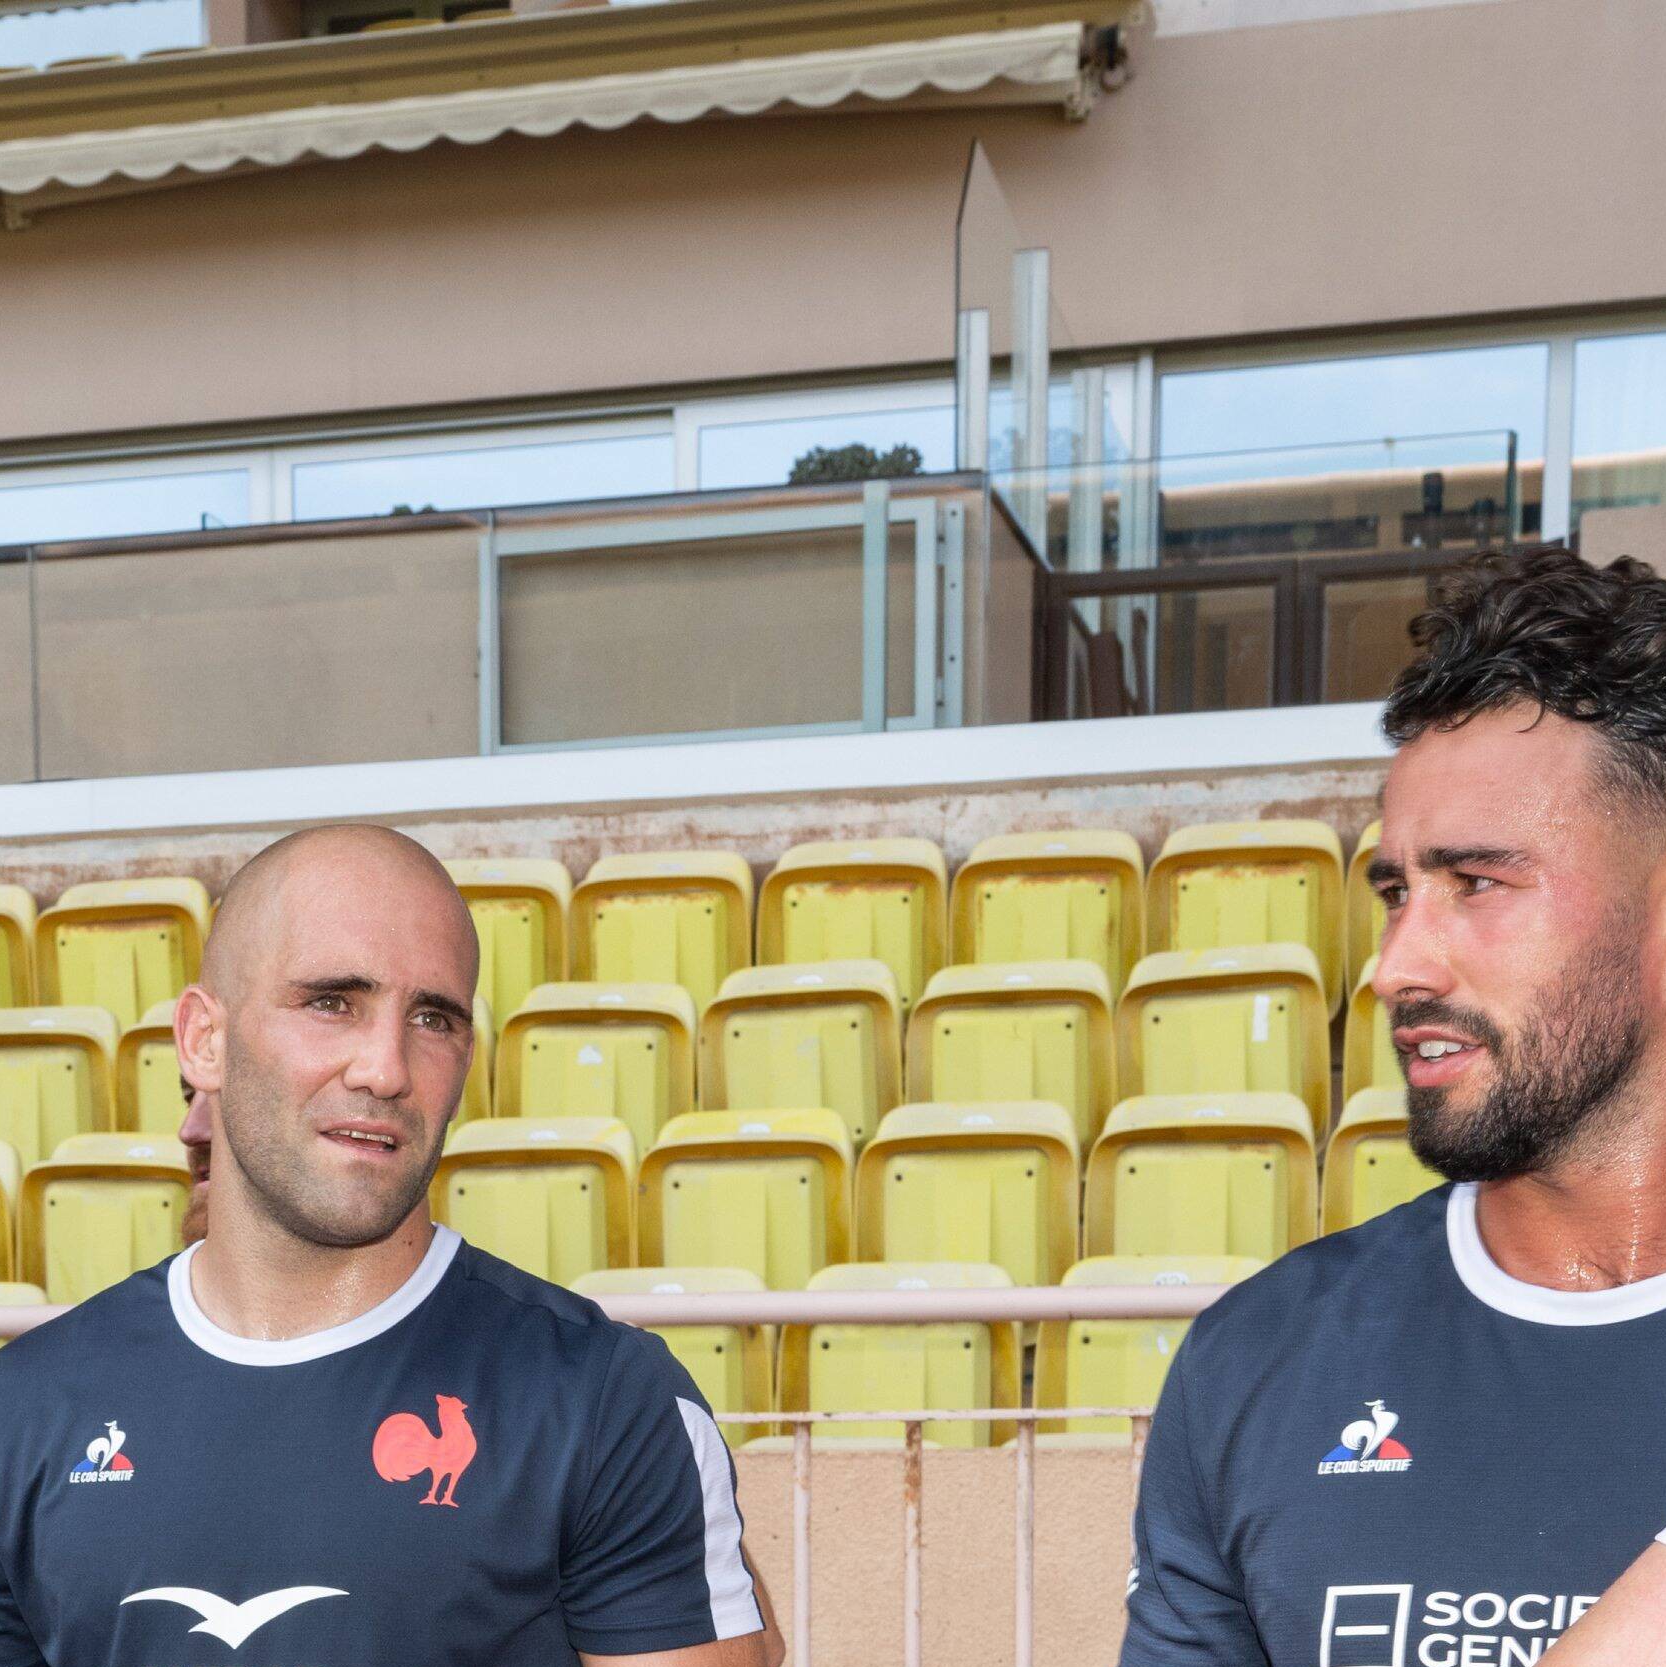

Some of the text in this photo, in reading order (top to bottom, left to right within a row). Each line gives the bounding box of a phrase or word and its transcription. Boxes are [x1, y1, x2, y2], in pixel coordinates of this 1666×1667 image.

[1317, 1461, 1334, 1475] LE
[1359, 1458, 1413, 1472] SPORTIF
[69, 1471, 80, 1483] LE
[98, 1469, 135, 1482] SPORTIF
